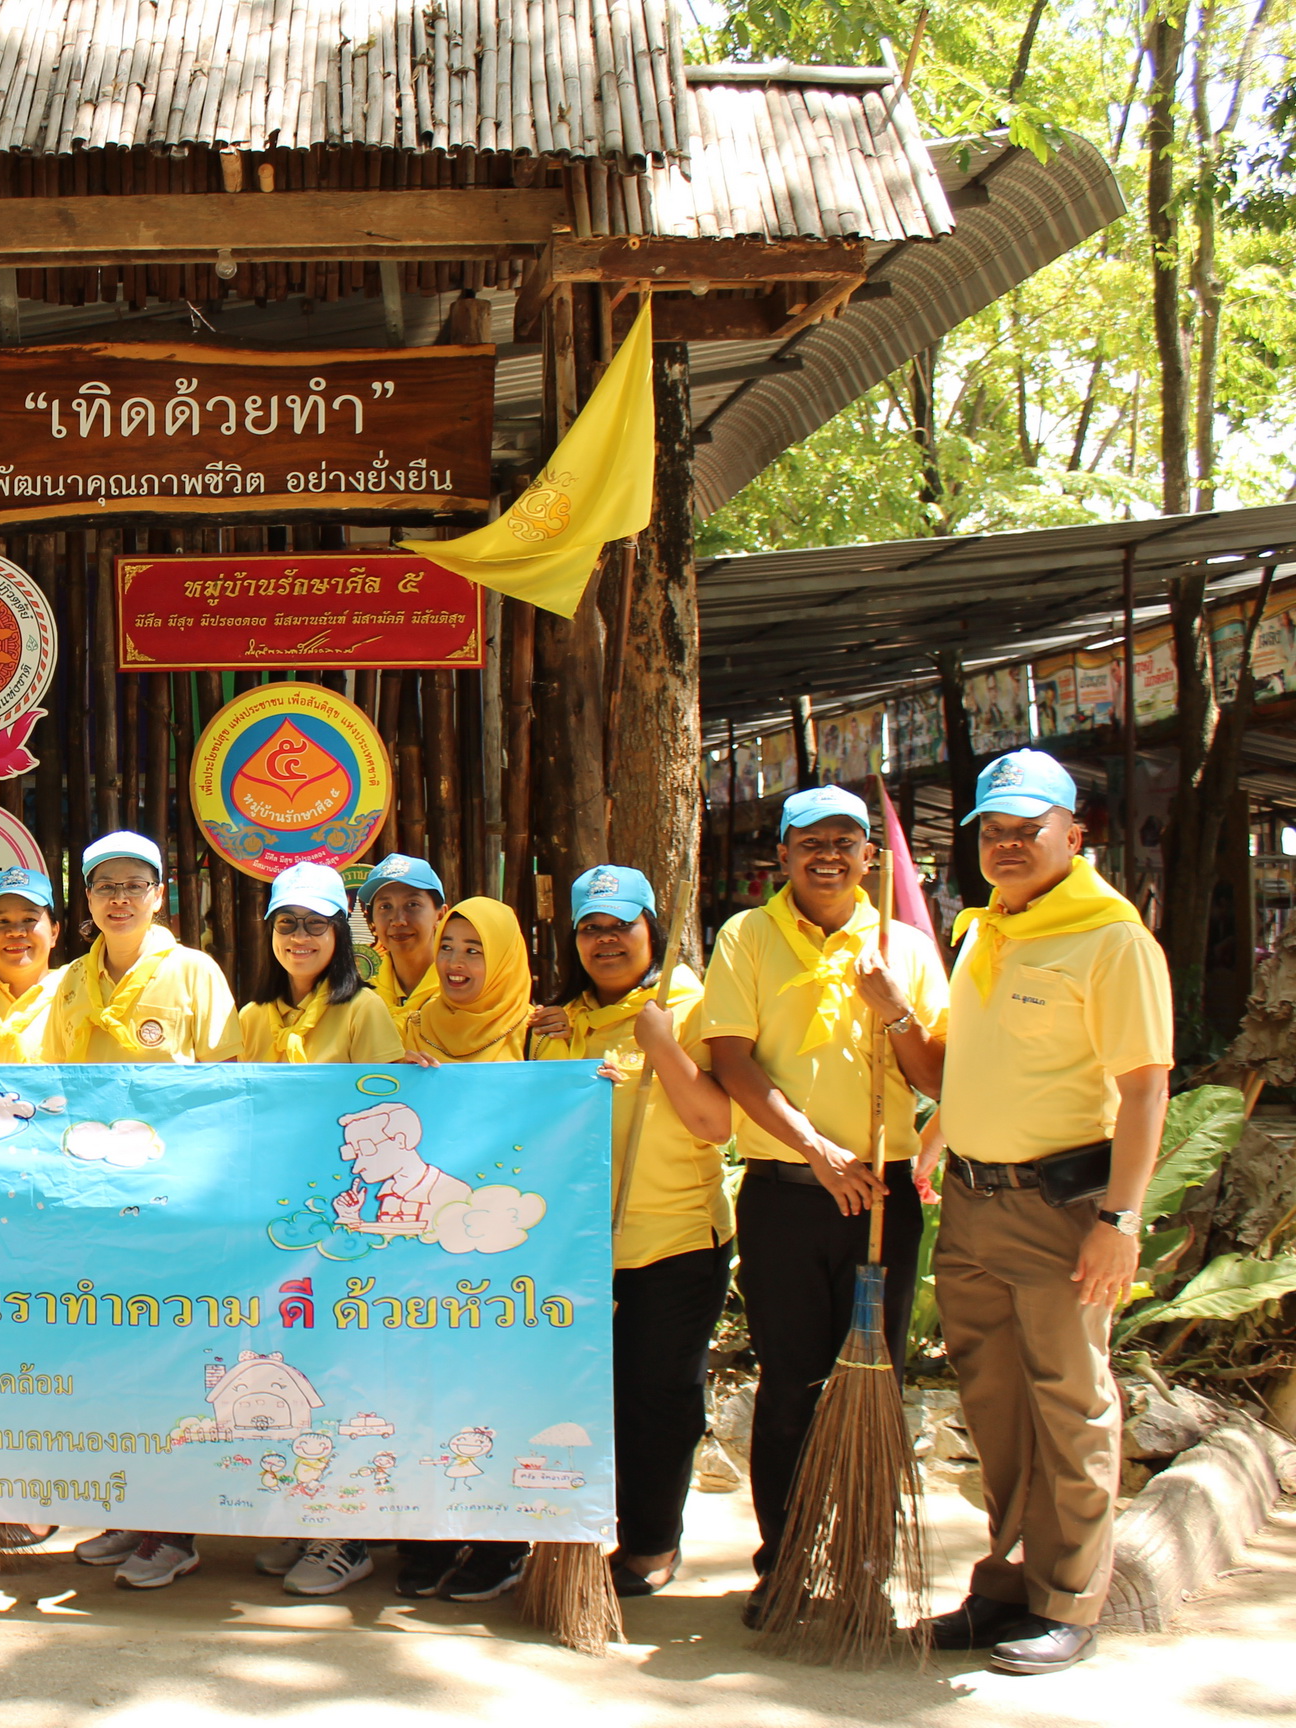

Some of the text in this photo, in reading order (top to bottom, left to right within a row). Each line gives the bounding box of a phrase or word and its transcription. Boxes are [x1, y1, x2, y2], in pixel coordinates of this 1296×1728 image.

[285, 449, 453, 493] อย่างยั่งยืน
[183, 568, 425, 607] หมู่บ้านรักษาศีล ๕
[134, 610, 466, 632] มีศีล มีสุข มีปรองดอง มีสมานฉันท์ มีสามัคคี มีสันติสุข
[198, 728, 230, 797] เพื่อประโยชน์สุข
[228, 697, 284, 729] แห่งประชาชน
[287, 691, 340, 719] เพื่อสันติสุข
[265, 738, 309, 781] ๕
[243, 793, 333, 824] หมู่บ้านรักษาศีล
[278, 1276, 315, 1329] ดี
[332, 1275, 575, 1330] ด้วยหัวใจ
